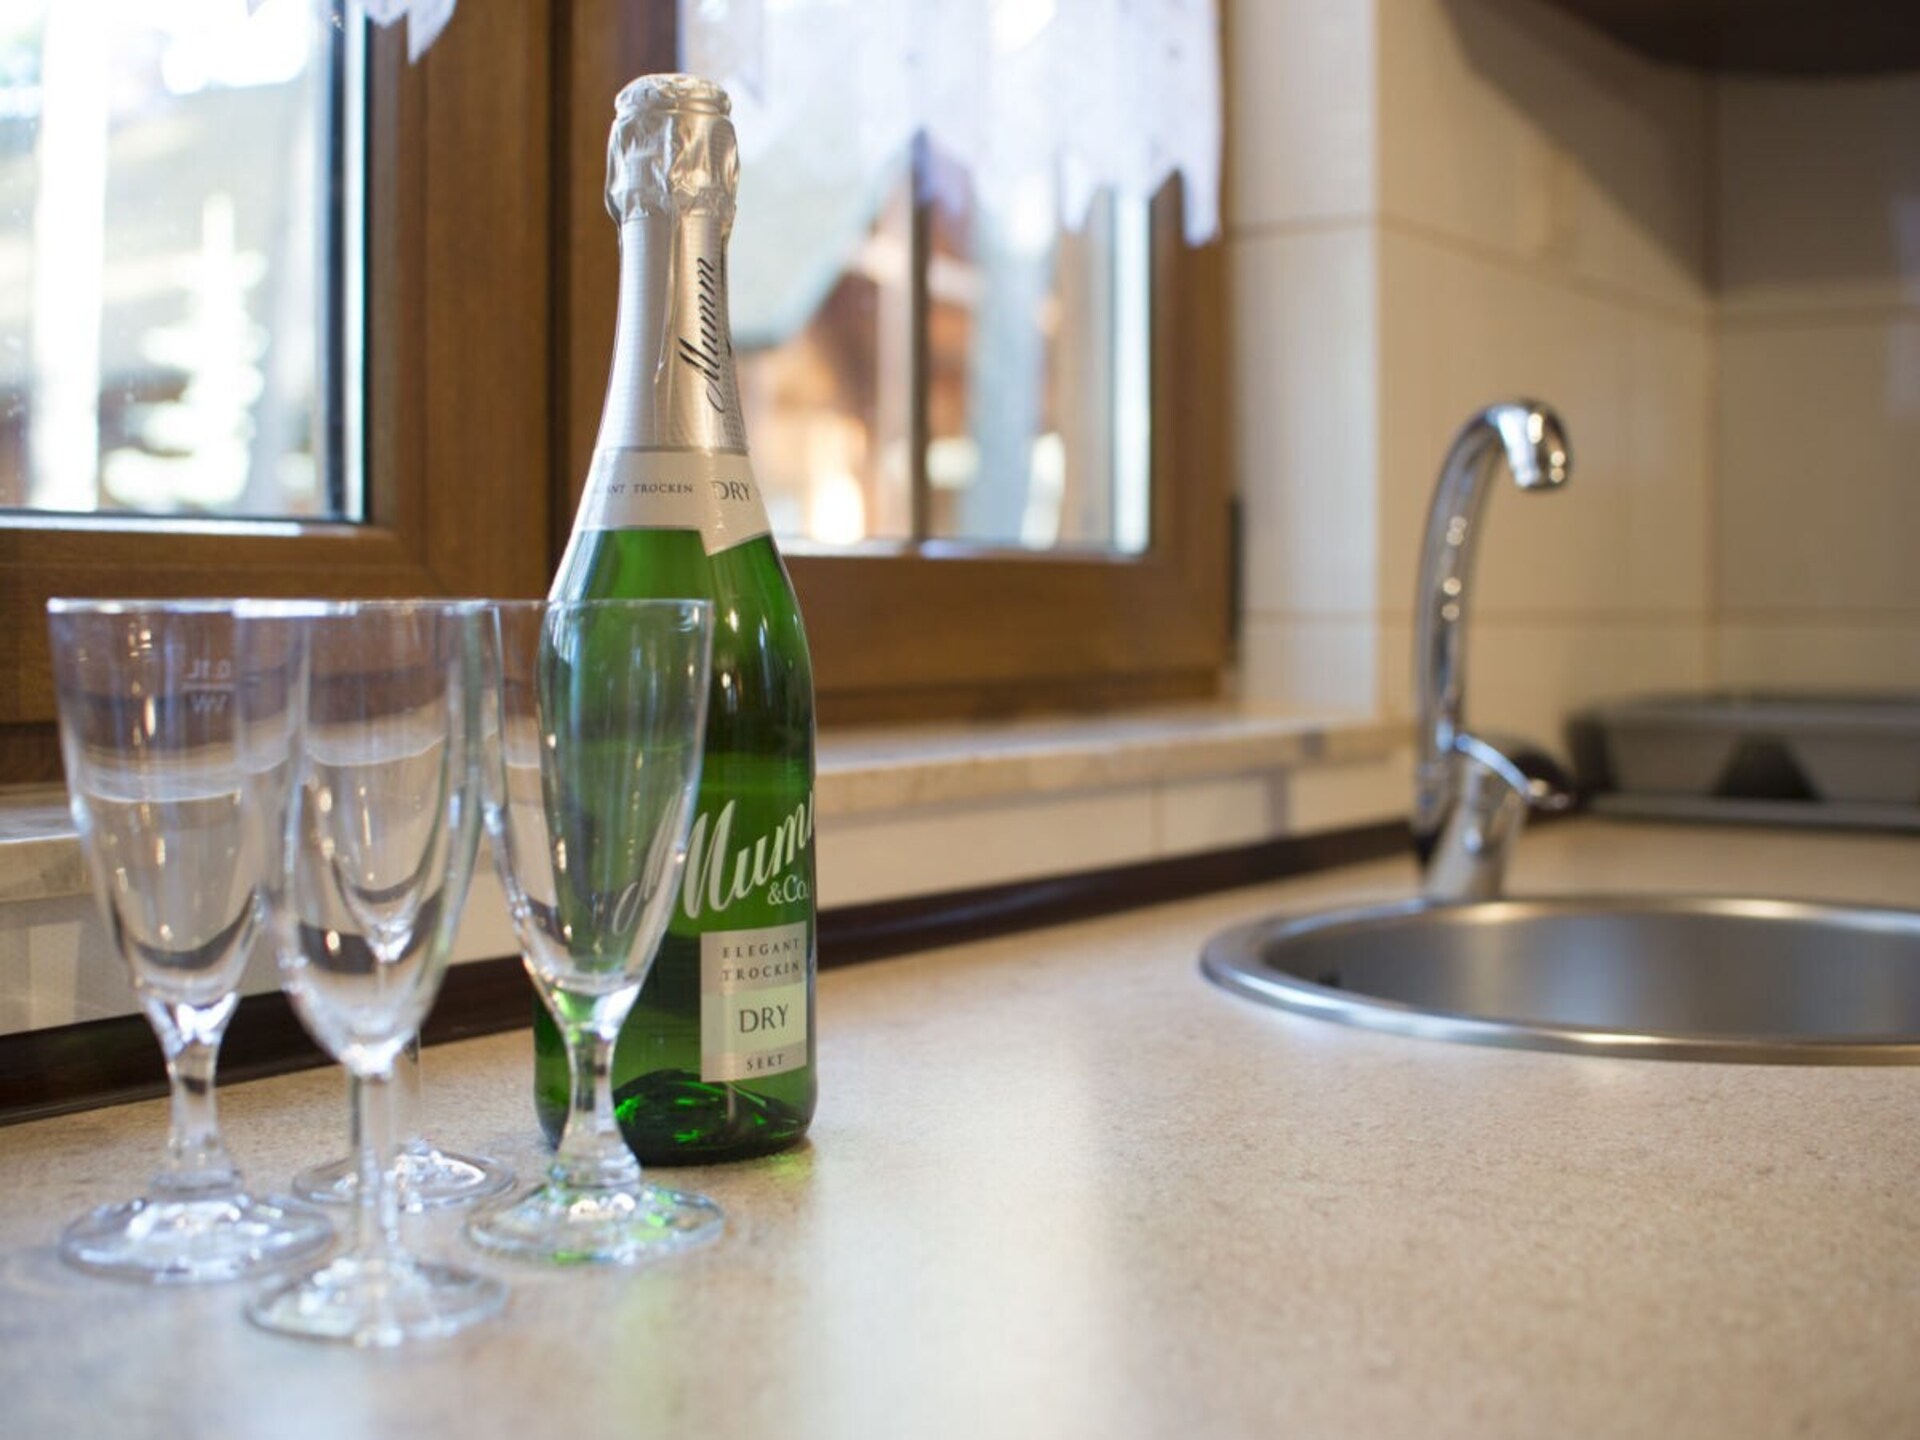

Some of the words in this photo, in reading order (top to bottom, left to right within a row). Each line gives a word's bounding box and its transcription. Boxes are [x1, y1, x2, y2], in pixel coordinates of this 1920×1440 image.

[678, 257, 726, 413] Mumm
[633, 482, 694, 494] TROCKEN
[712, 480, 751, 502] DRY
[723, 938, 799, 959] ELEGANT
[722, 961, 800, 981] TROCKEN
[739, 1003, 789, 1033] DRY
[746, 1053, 784, 1071] SEKT
